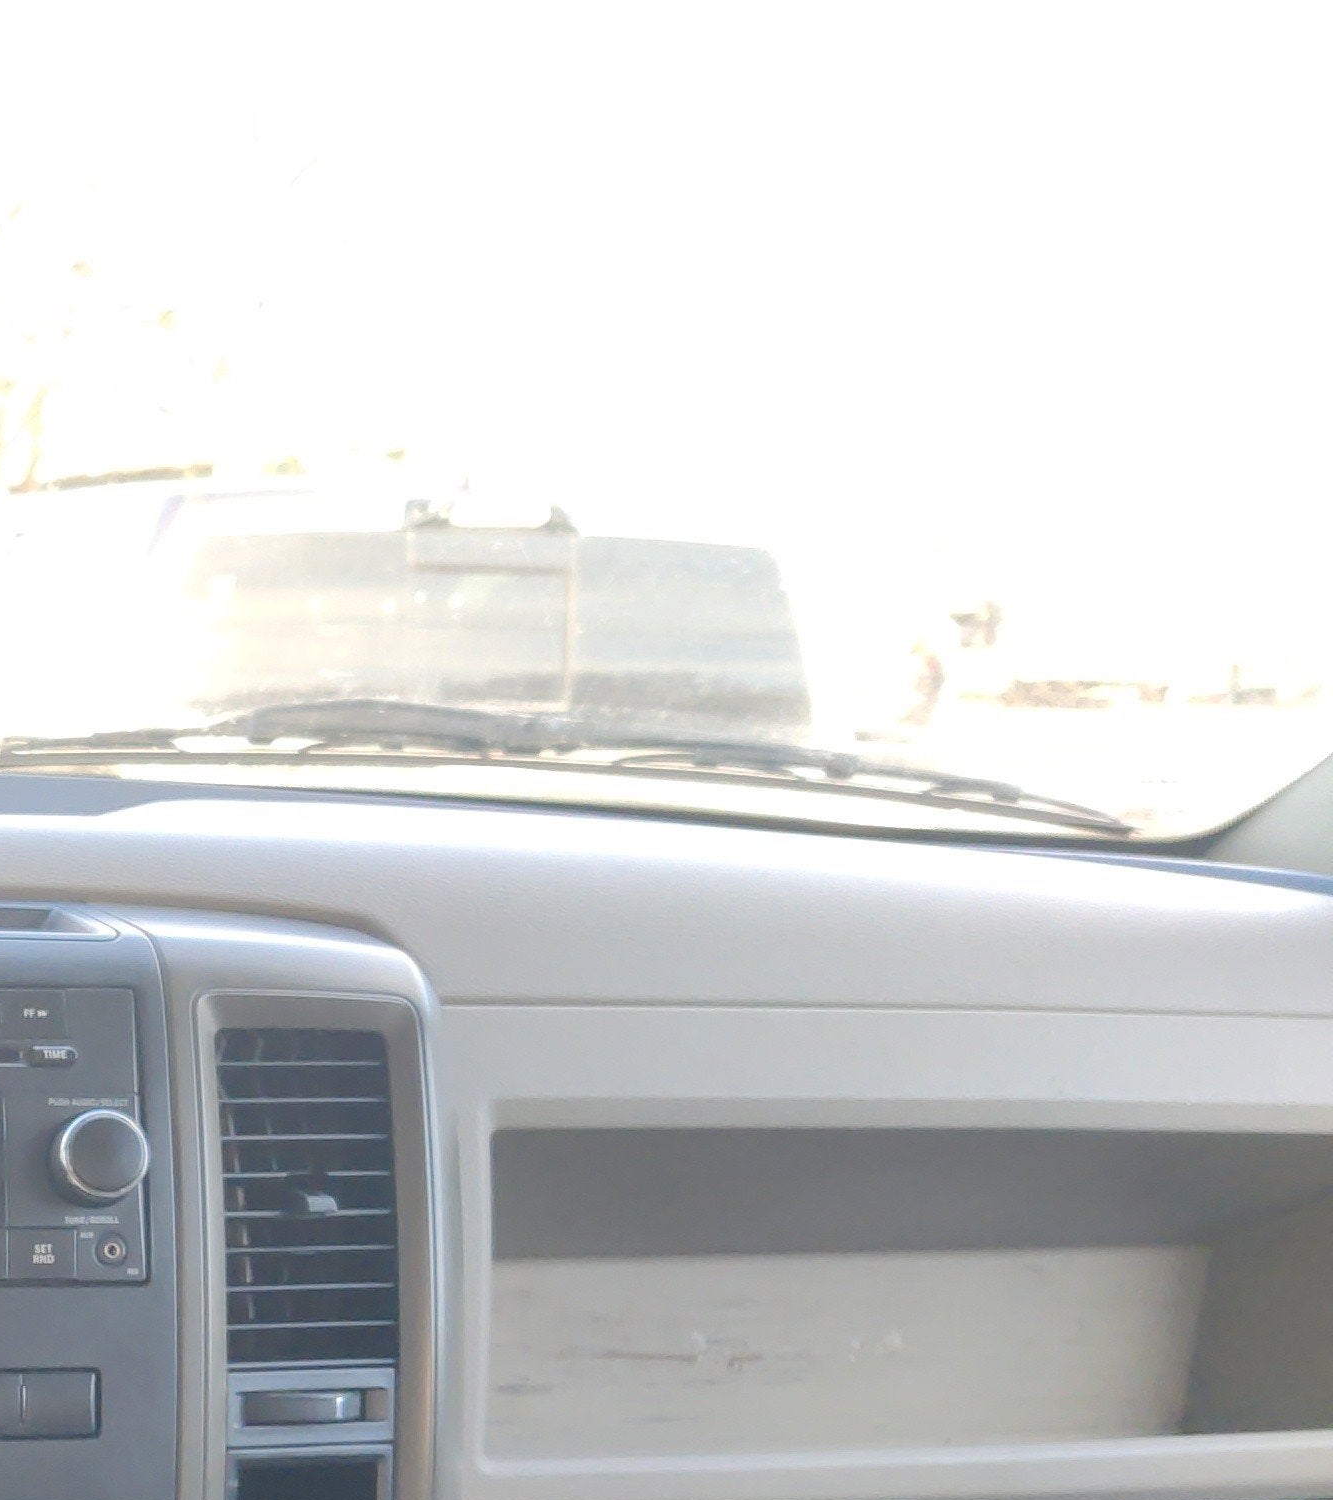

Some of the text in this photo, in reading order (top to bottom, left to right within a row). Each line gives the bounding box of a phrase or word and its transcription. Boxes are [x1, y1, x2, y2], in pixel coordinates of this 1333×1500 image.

[23, 1008, 36, 1019] FF
[42, 1049, 69, 1060] TIME
[34, 1243, 53, 1254] SET
[33, 1253, 56, 1265] RND
